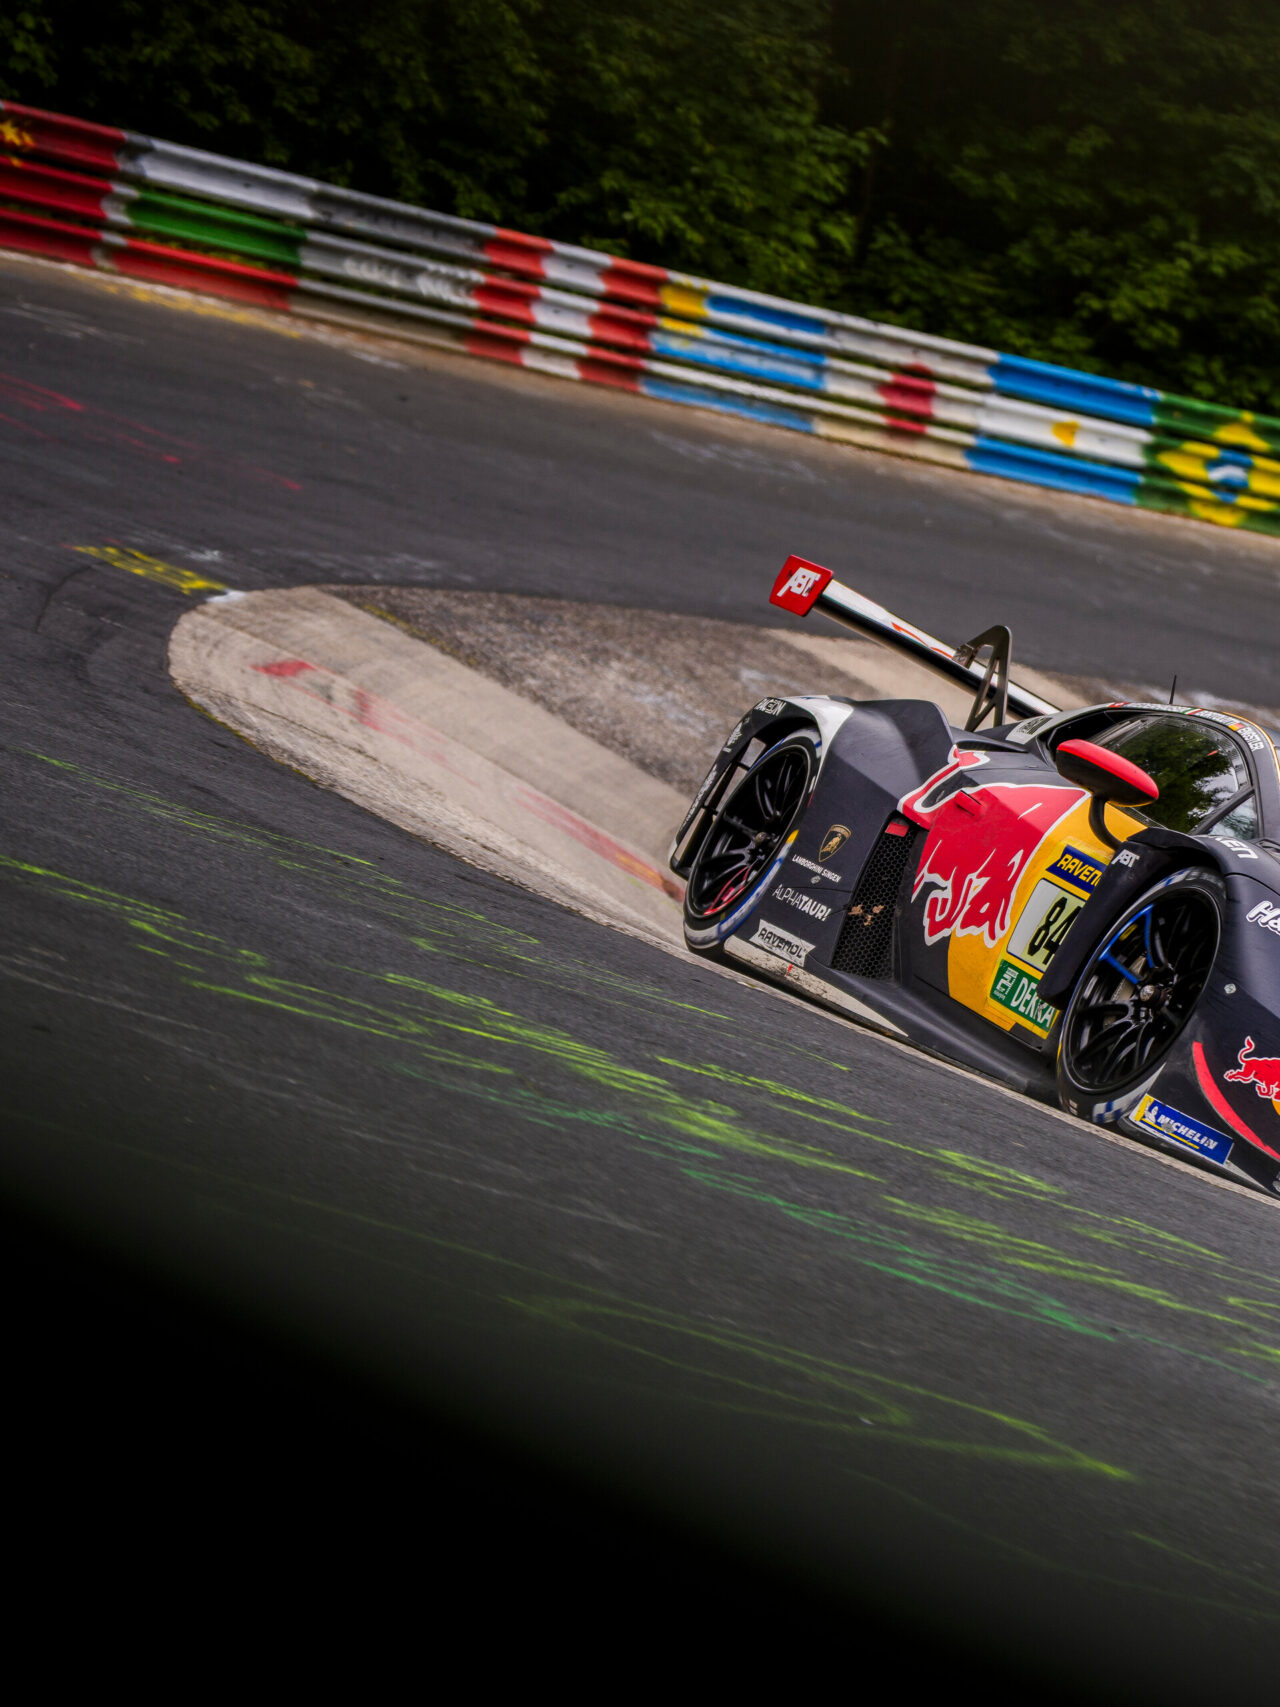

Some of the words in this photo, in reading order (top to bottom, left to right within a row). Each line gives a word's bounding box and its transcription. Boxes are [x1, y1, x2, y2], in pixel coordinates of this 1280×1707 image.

[776, 566, 821, 597] ABT
[792, 854, 822, 875] LAMBORGHINI
[821, 868, 842, 883] SINGEN
[1111, 848, 1140, 868] ABT
[757, 927, 806, 959] RAVENOL
[1027, 896, 1083, 965] 84
[1010, 976, 1056, 1029] DEKRA
[1157, 1114, 1219, 1150] MICHELIN
